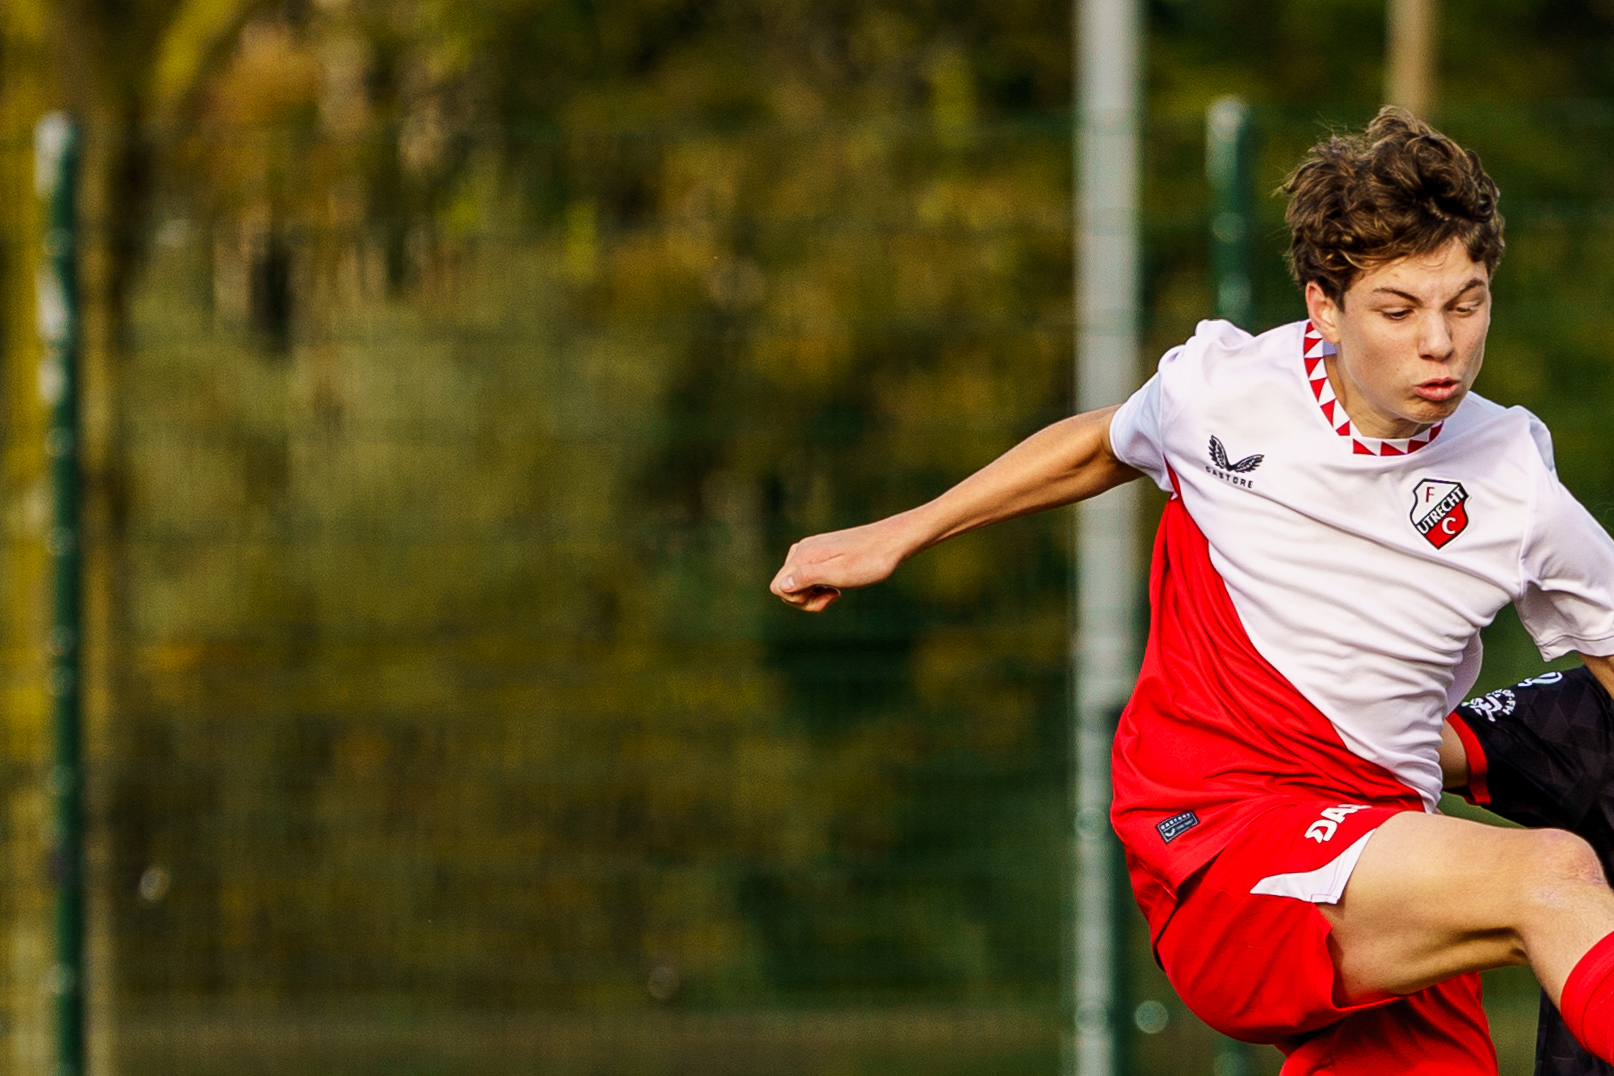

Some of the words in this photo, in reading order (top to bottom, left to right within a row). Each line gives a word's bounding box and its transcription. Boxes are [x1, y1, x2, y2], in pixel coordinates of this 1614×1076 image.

[1205, 465, 1253, 489] CASTORE
[1425, 486, 1435, 503] F
[1416, 486, 1465, 535] UTRECHT
[1441, 516, 1457, 535] C
